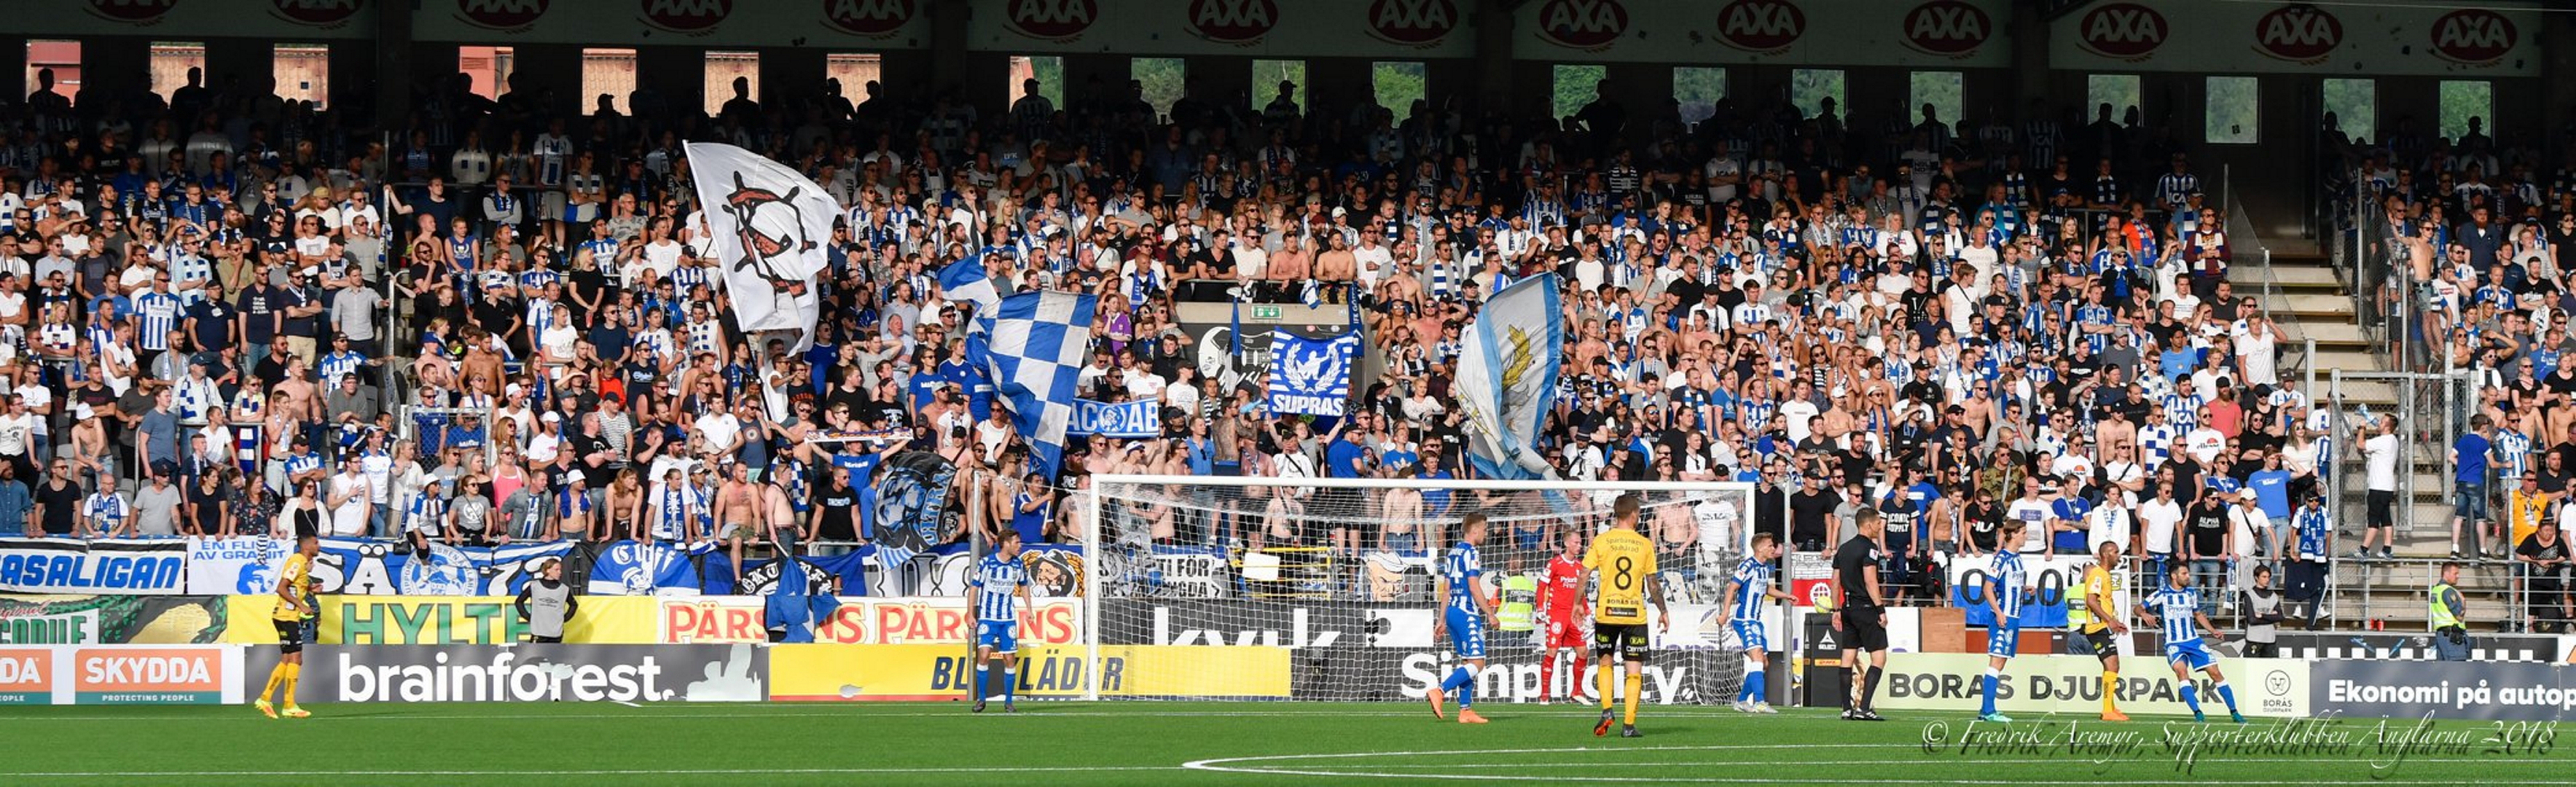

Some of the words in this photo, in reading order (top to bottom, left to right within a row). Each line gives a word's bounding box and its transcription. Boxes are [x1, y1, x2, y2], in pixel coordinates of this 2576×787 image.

[1016, 0, 1091, 25] AXA
[1197, 0, 1272, 27] AXA
[1376, 0, 1451, 30] AXA
[1548, 0, 1620, 34] AXA
[1726, 2, 1799, 36] AXA
[1911, 7, 1984, 41] AXA
[2088, 9, 2161, 44] AXA
[2263, 12, 2336, 46] AXA
[2437, 15, 2510, 49] AXA
[1272, 394, 1344, 417] SUPRAS
[193, 552, 217, 560] AV
[201, 541, 225, 550] EN
[232, 541, 279, 549] FLIA
[0, 555, 182, 589] ASALIGAN
[1614, 555, 1632, 590] 8
[85, 657, 211, 684] SKYDDA
[2263, 697, 2293, 707] BORÅS
[2329, 679, 2448, 703] Ekonomi
[2456, 679, 2491, 709] på
[2499, 684, 2576, 710] autop
